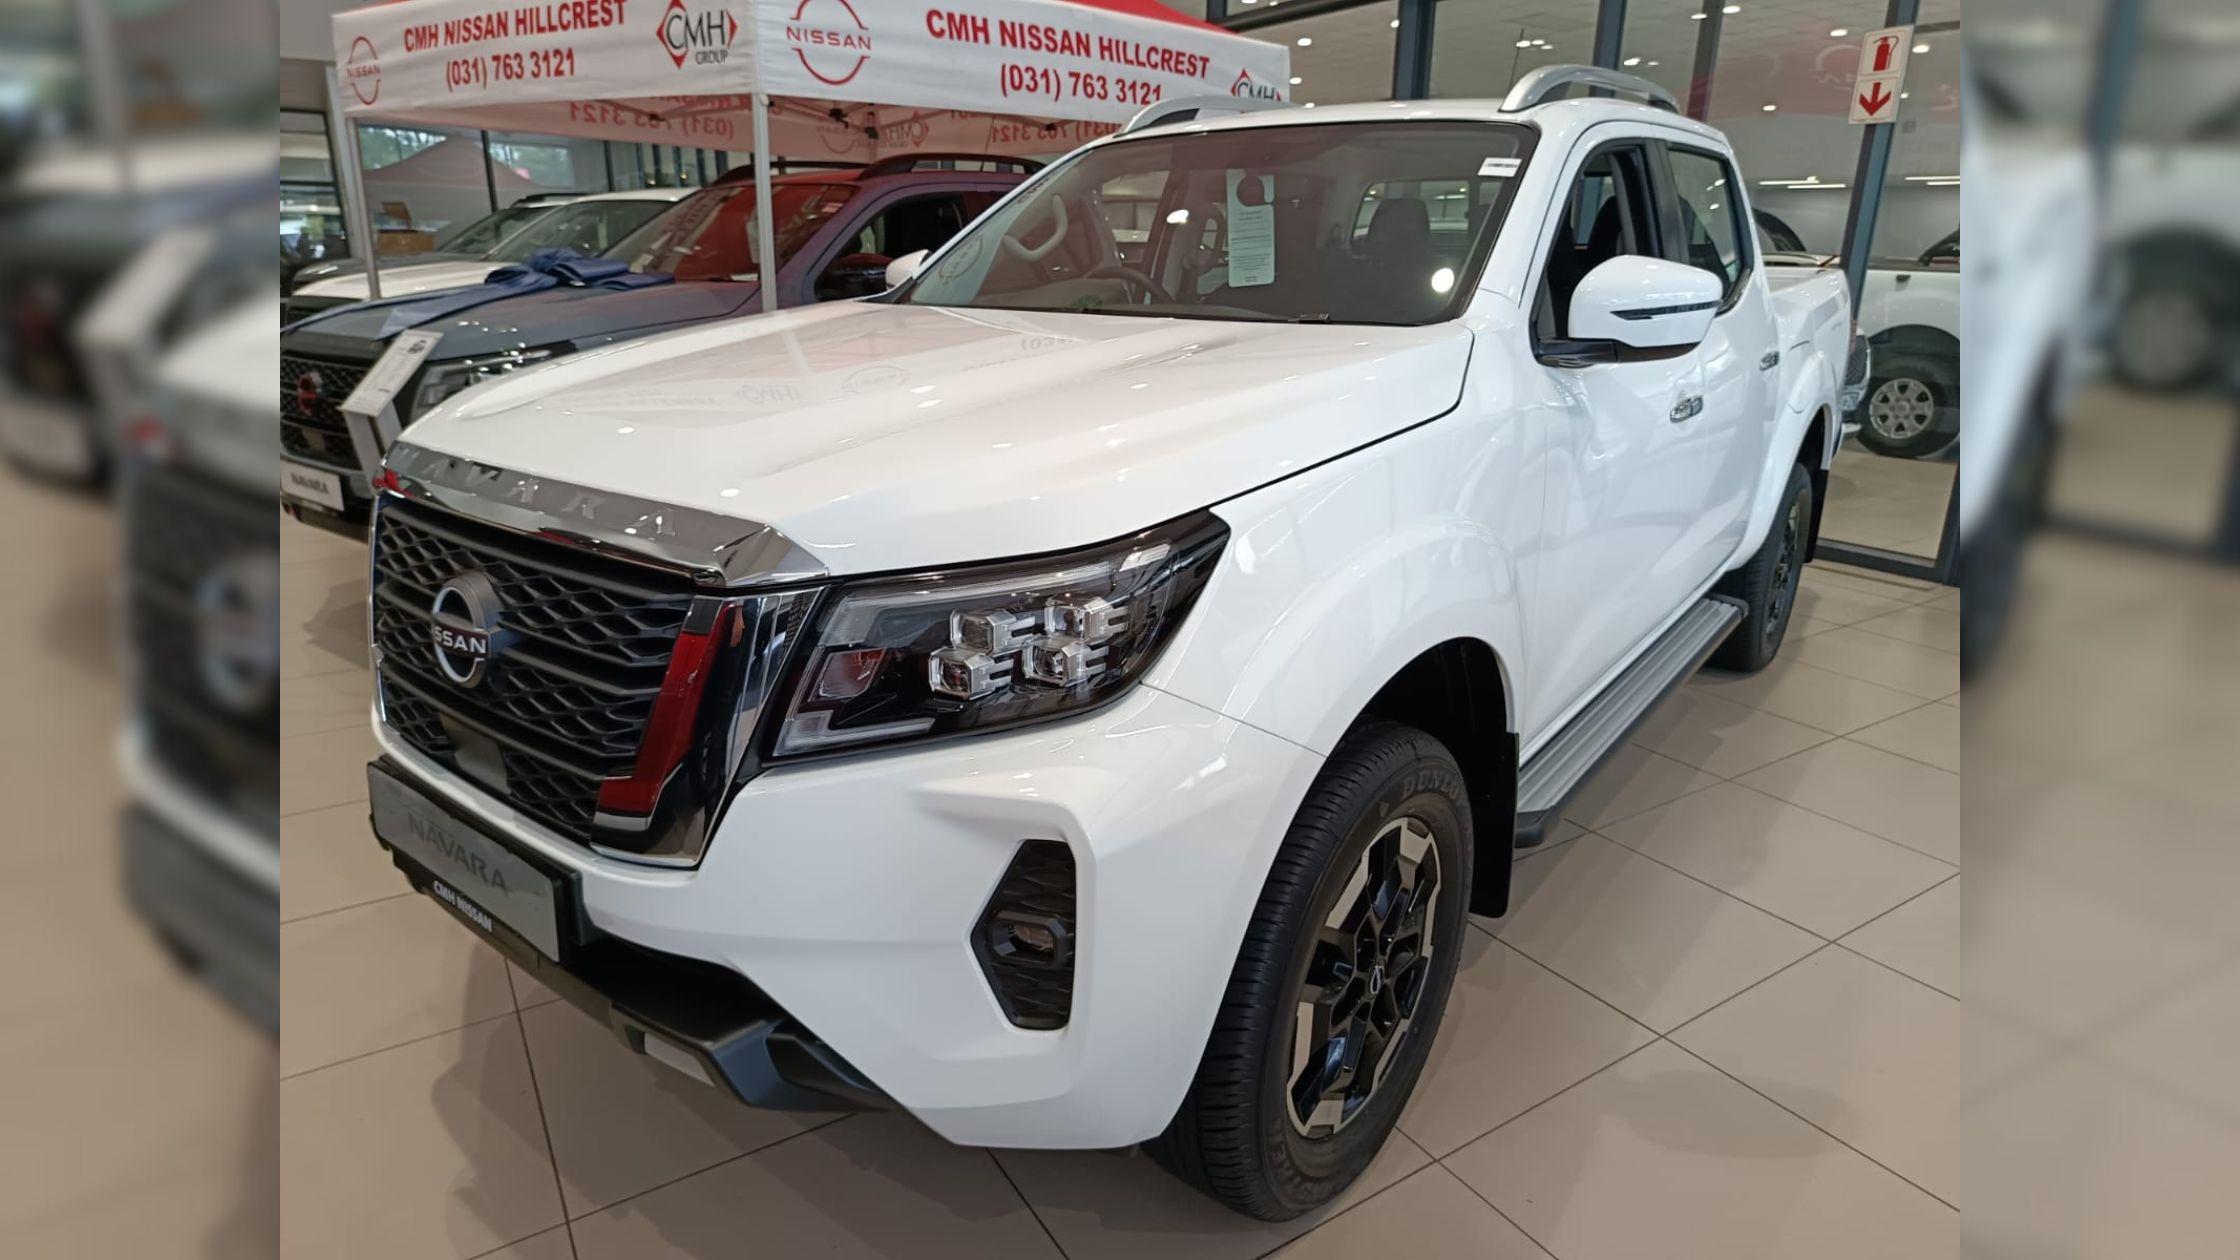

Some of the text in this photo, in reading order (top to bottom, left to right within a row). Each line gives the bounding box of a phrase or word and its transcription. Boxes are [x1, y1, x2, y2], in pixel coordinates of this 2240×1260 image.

[404, 0, 627, 52] CMH NISSAN HILLCREST
[666, 9, 726, 50] CMH
[786, 26, 872, 51] NISSAN
[926, 9, 1210, 79] CMH NISSAN HILLCREST
[346, 64, 381, 78] NISSAN
[446, 47, 575, 92] (031) 763 3121
[695, 50, 729, 65] GROUP
[1001, 63, 1162, 106] (031) 763 3121
[408, 812, 509, 897] NAVARA
